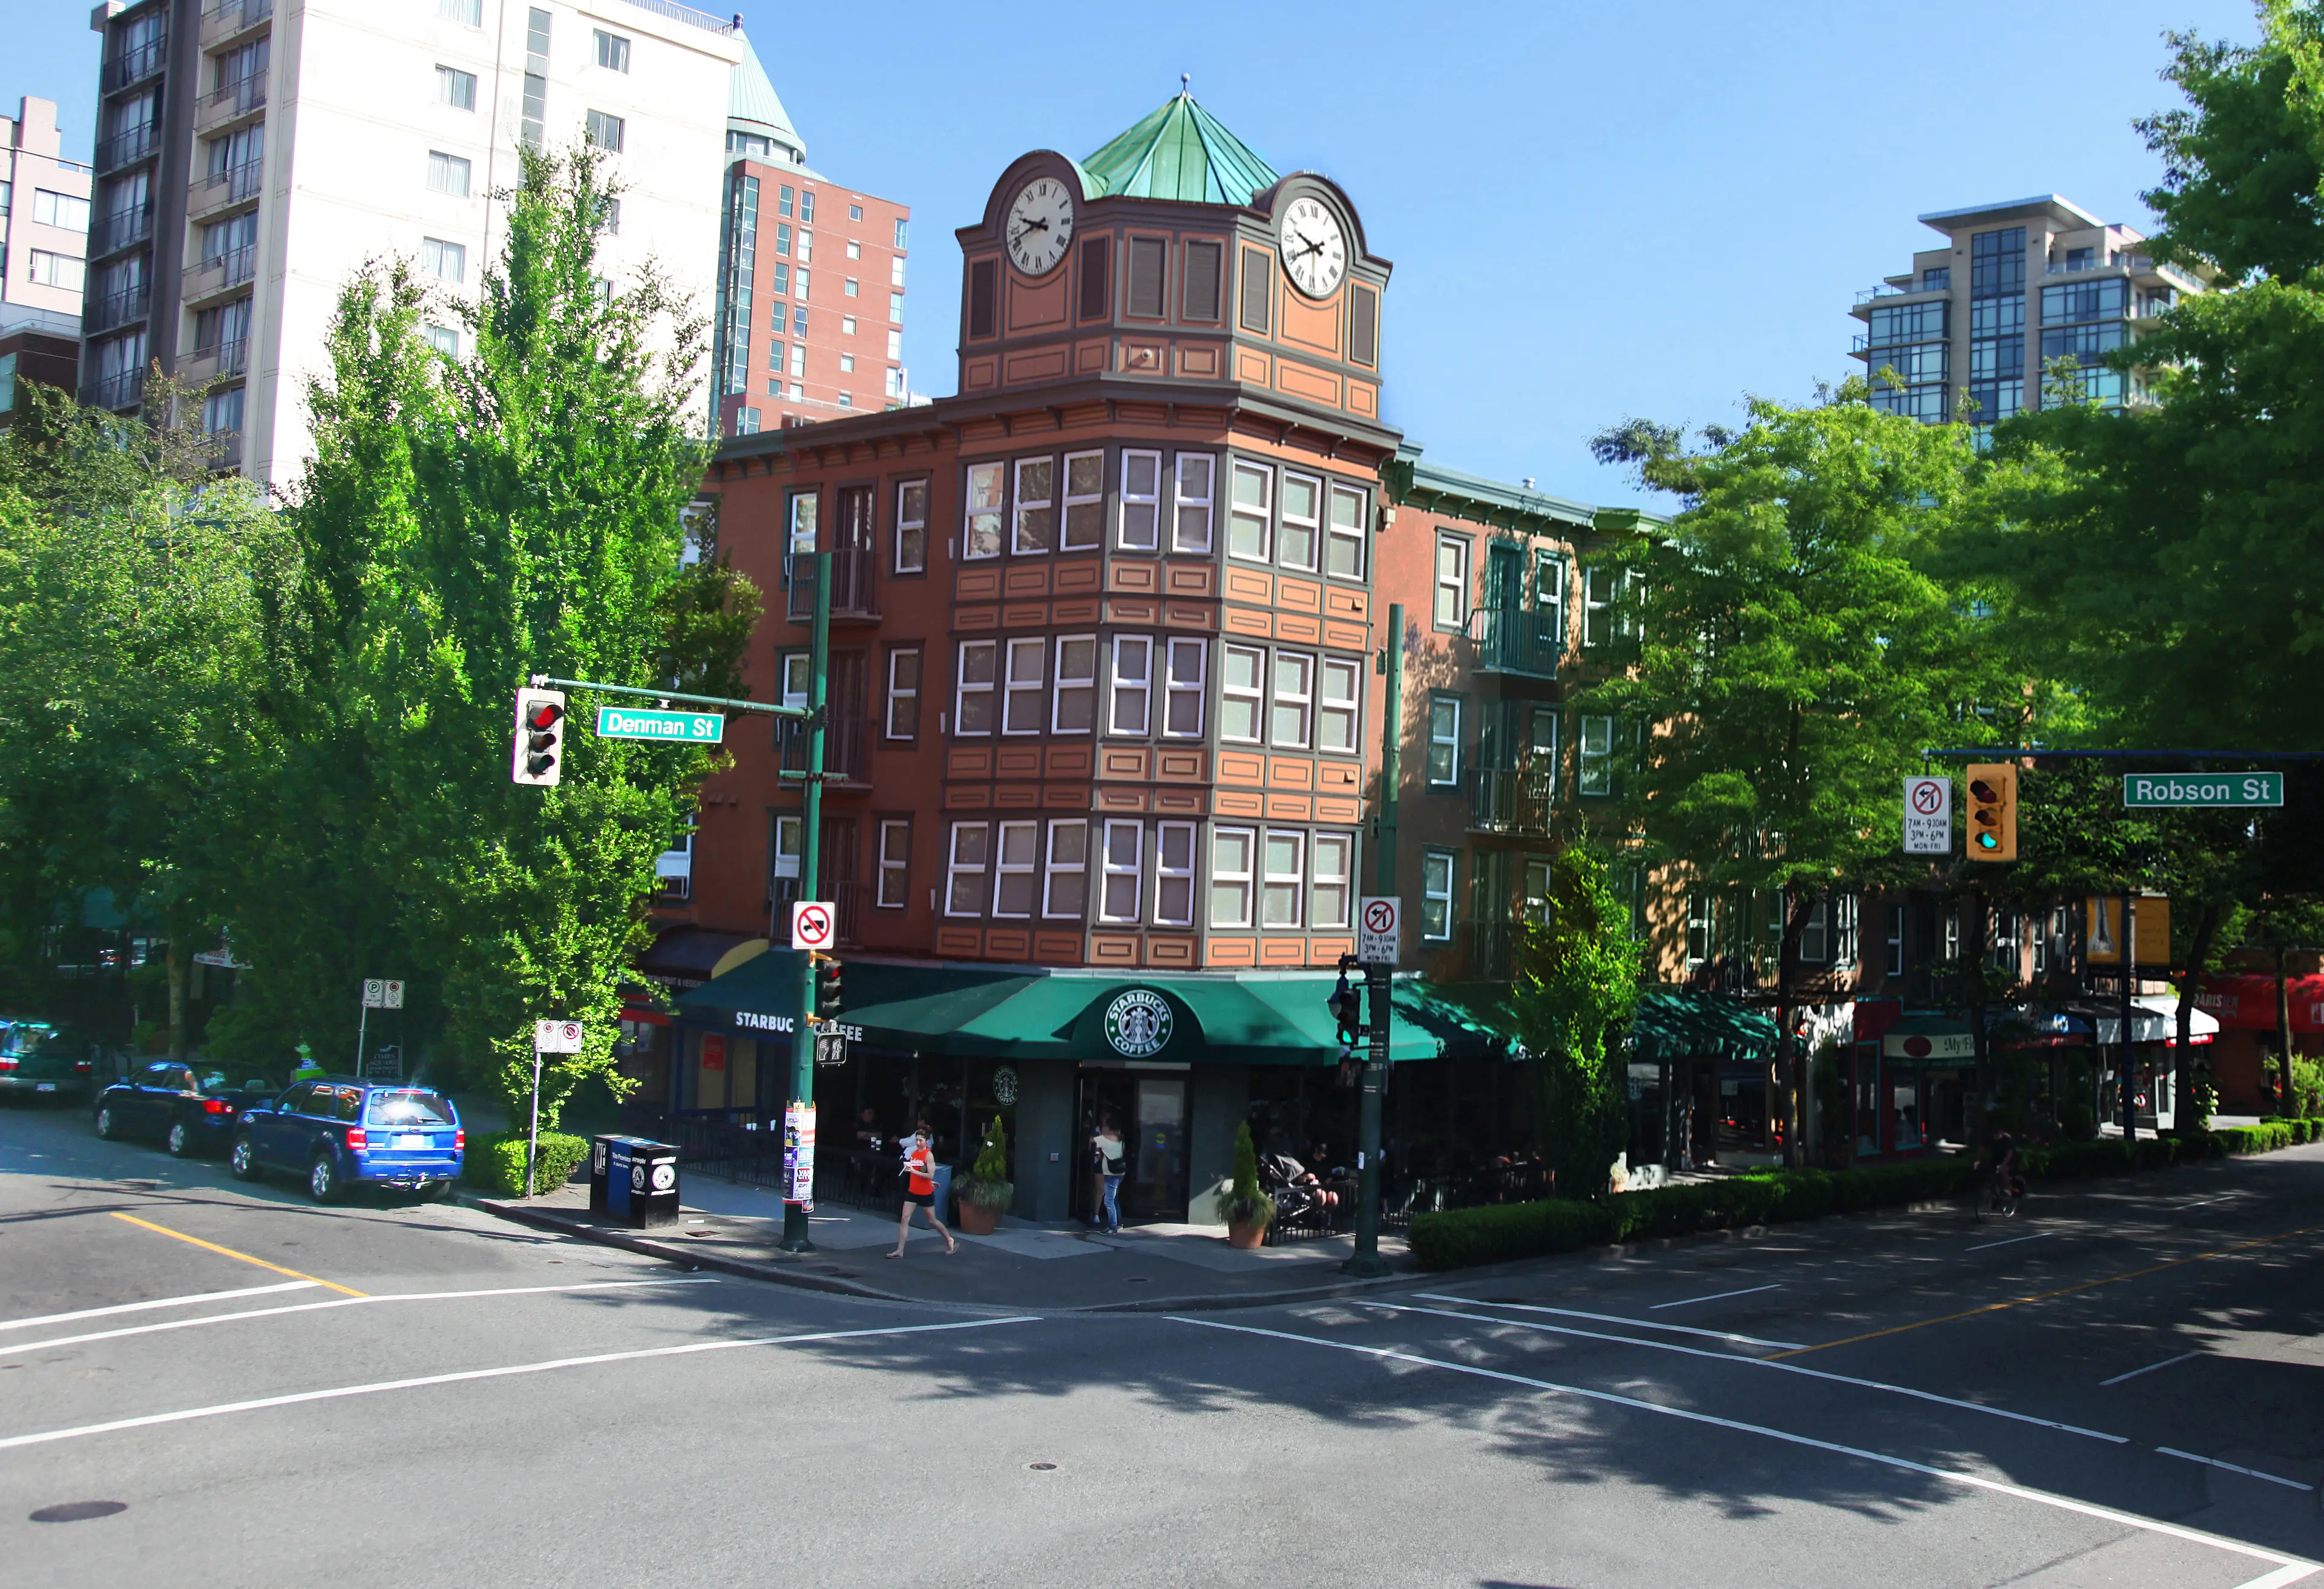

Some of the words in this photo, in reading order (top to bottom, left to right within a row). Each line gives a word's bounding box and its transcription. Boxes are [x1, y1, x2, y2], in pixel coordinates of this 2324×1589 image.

[607, 712, 685, 735] Denman
[692, 717, 714, 737] St
[2136, 779, 2230, 801] Robson
[2242, 778, 2270, 800] St
[1908, 818, 1921, 830] 7AM
[1911, 829, 1924, 841] 3PM
[1930, 830, 1944, 841] 6PM
[1362, 933, 1374, 944] 7AM
[1364, 943, 1376, 954] 3PM
[1381, 944, 1393, 955] 6PM
[1109, 993, 1169, 1022] STARBUCKS
[735, 1011, 794, 1033] STARBUC
[813, 1022, 863, 1042] CFEE
[1114, 1036, 1160, 1054] COFFEE
[1944, 1037, 1961, 1054] My
